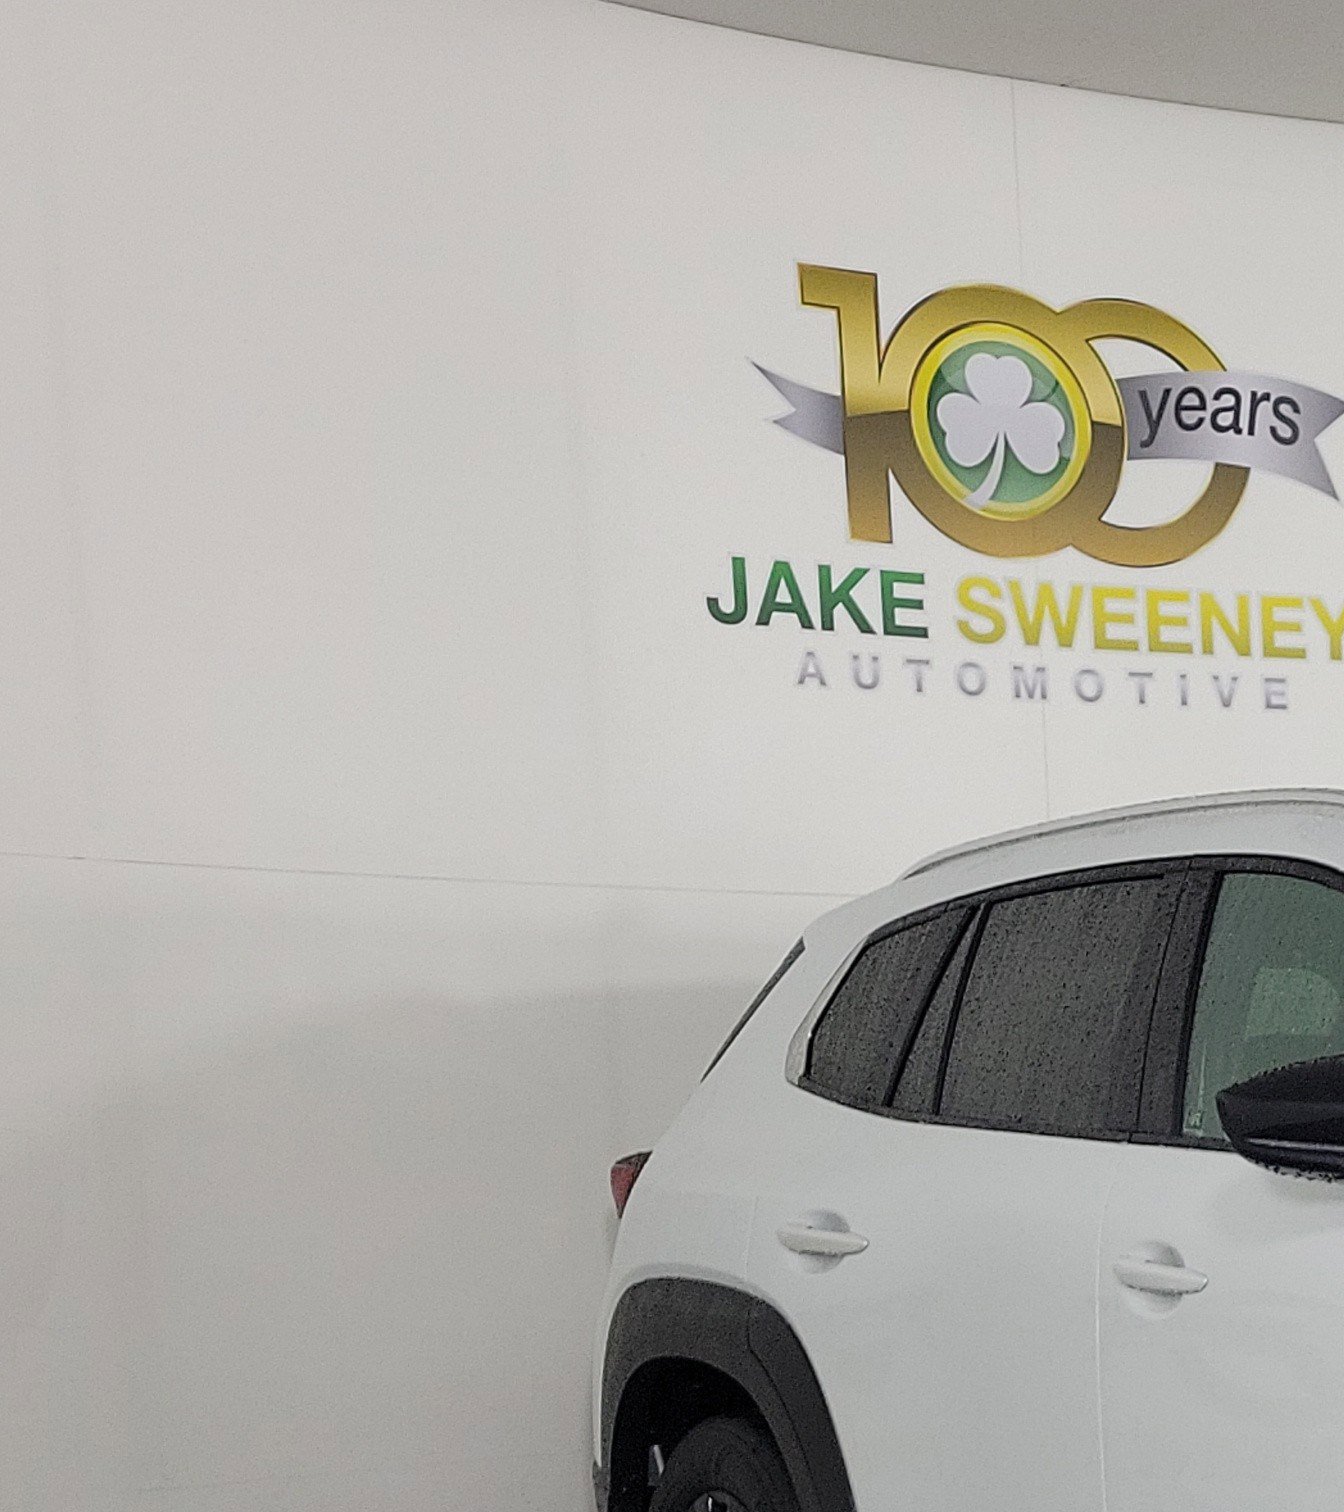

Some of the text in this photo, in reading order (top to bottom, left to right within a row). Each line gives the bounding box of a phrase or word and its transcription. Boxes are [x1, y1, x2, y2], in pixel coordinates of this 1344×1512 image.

[1138, 382, 1302, 449] years
[706, 555, 930, 639] JAKE
[796, 651, 1290, 711] AUTOMOTIVE
